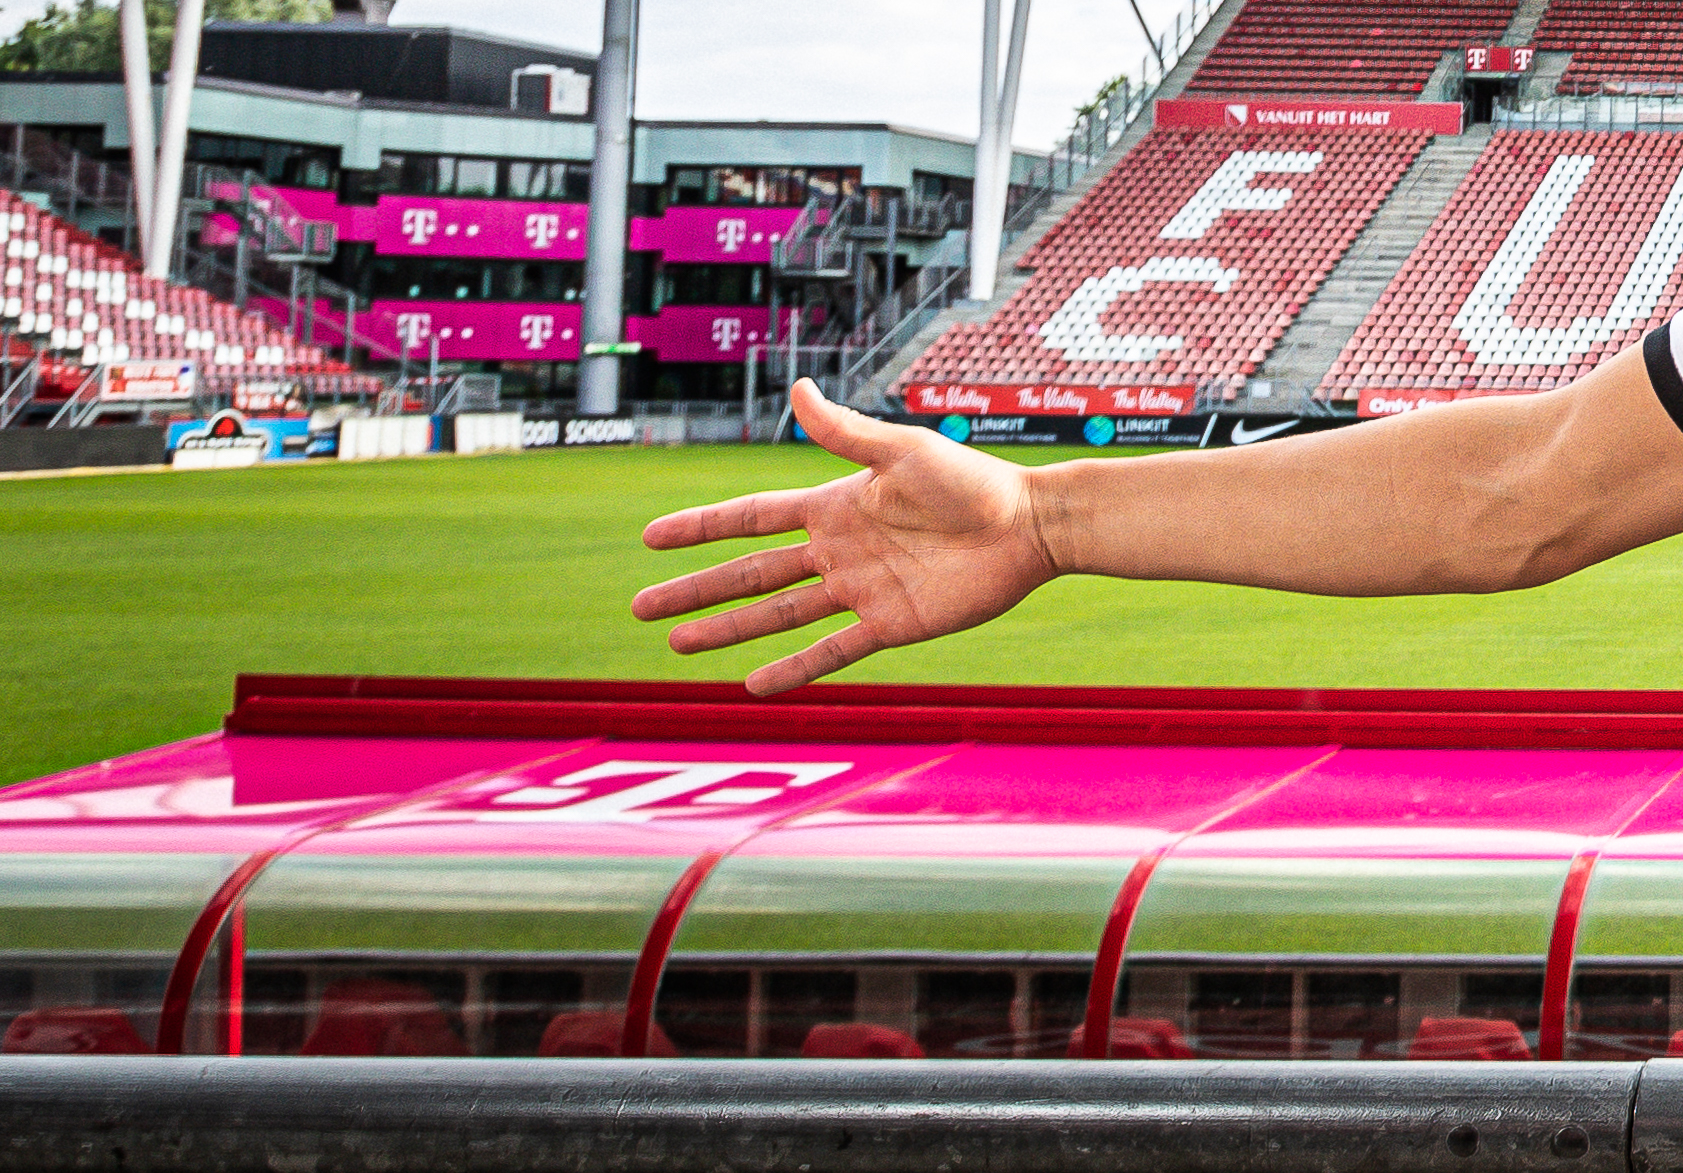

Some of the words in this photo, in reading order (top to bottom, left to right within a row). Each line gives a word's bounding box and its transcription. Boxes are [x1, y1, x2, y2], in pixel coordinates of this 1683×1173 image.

[1467, 48, 1487, 70] T
[1514, 49, 1533, 71] T
[1256, 109, 1313, 125] VANUIT
[1317, 110, 1346, 125] HET
[1349, 111, 1391, 126] HART
[1159, 150, 1324, 240] F
[402, 208, 438, 245] T
[524, 214, 560, 249] T
[717, 218, 747, 253] T
[1039, 256, 1237, 361] C
[396, 312, 432, 348] T
[519, 314, 555, 350] T
[711, 317, 742, 351] T
[919, 387, 945, 406] The
[945, 385, 991, 415] Valley
[1016, 387, 1042, 408] The
[1042, 386, 1088, 416] Valley
[1112, 388, 1137, 408] The
[1138, 386, 1184, 414] Valley
